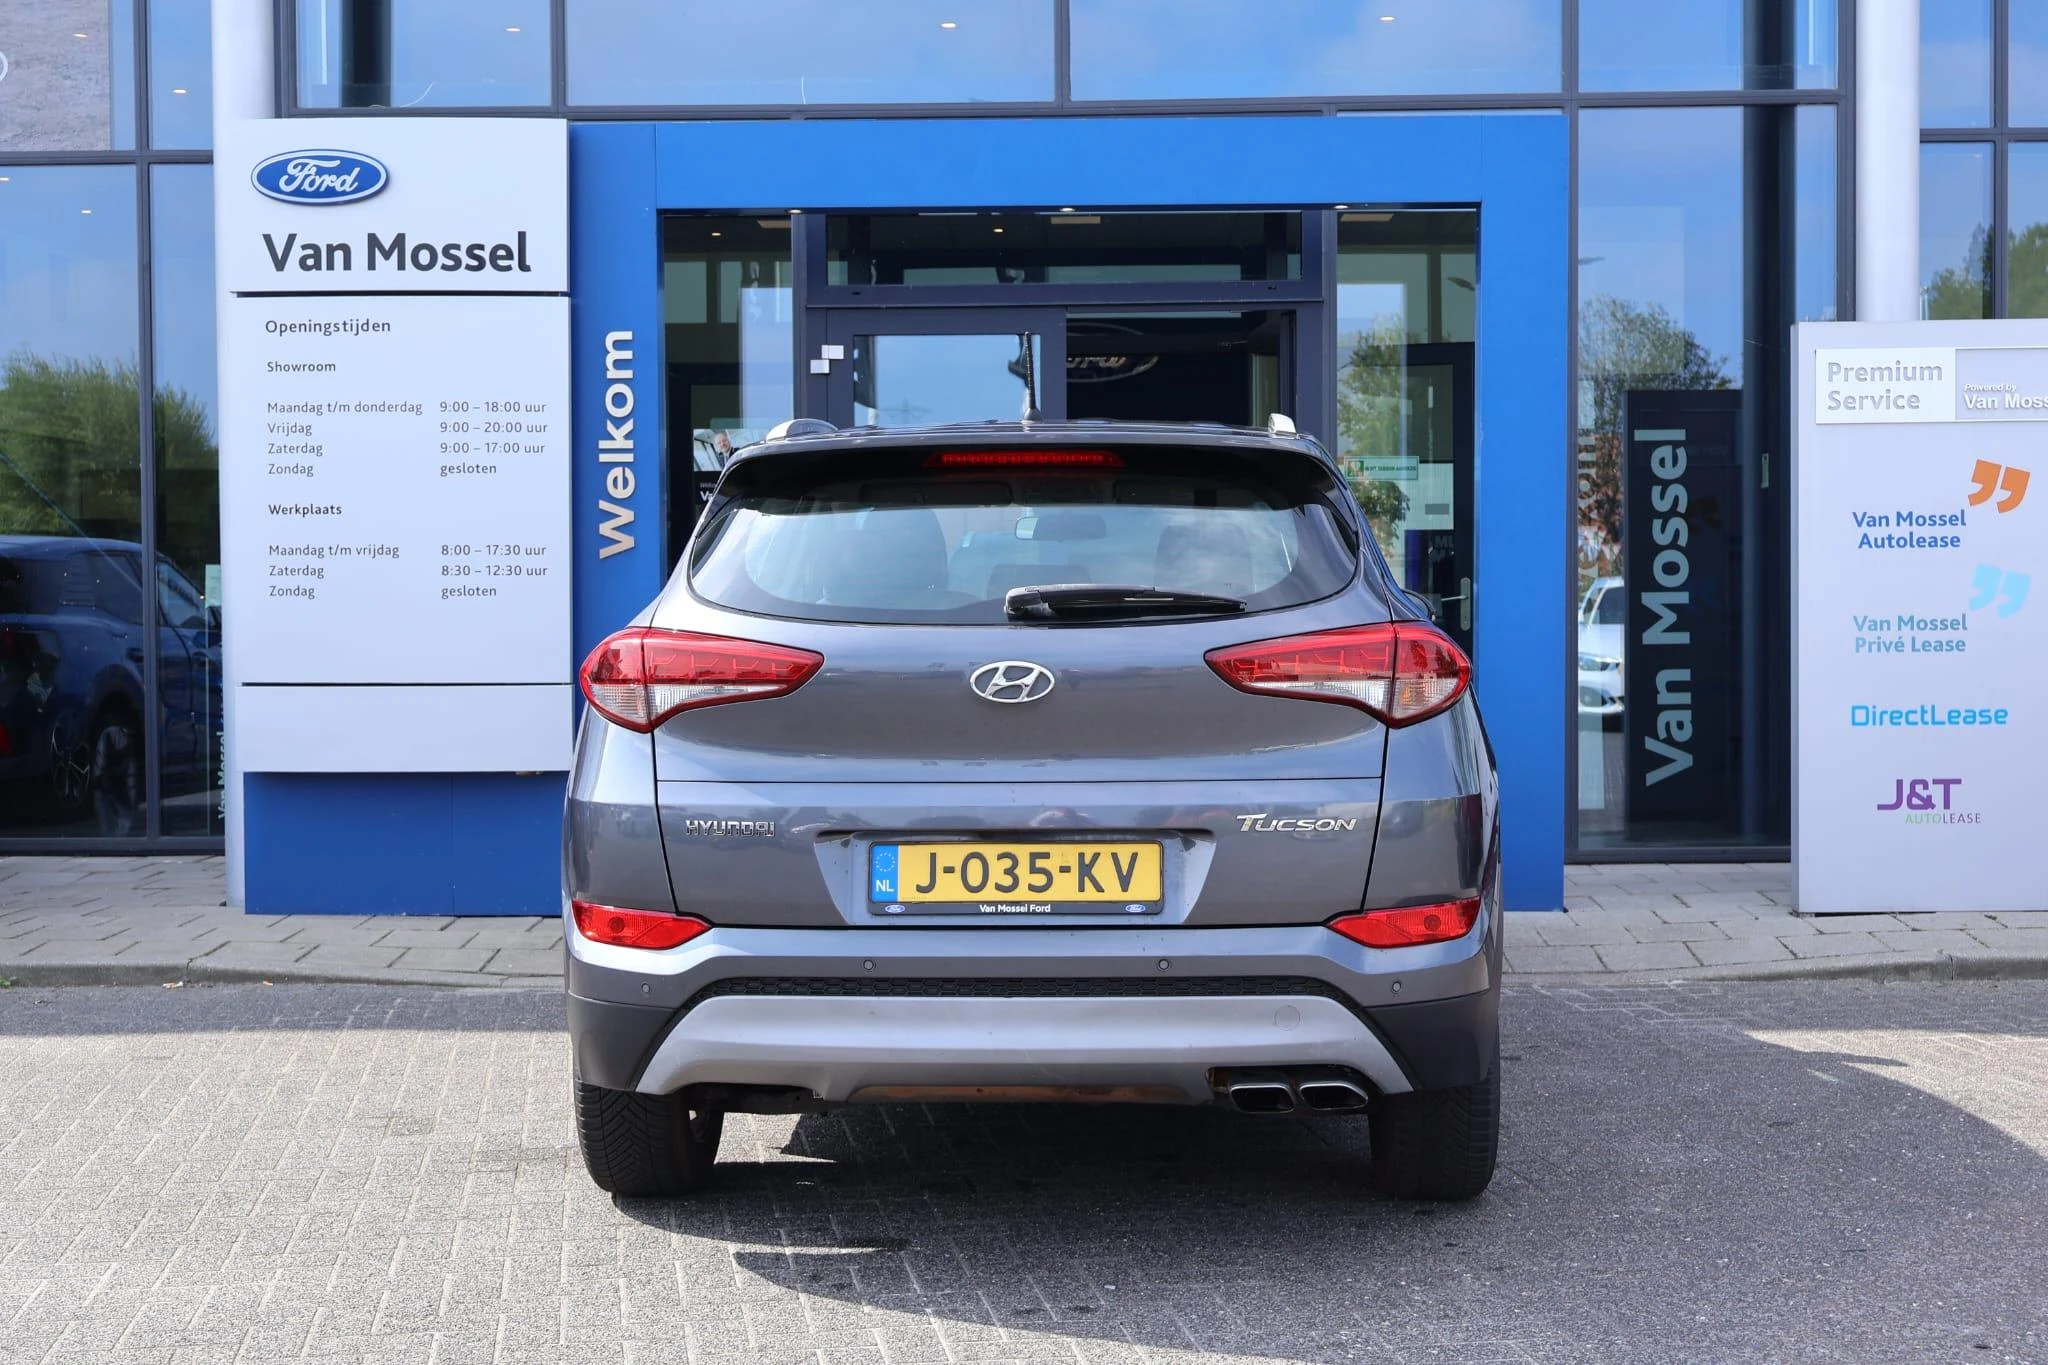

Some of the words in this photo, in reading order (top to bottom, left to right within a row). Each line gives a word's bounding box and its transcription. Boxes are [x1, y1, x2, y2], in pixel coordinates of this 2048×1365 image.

[278, 159, 361, 194] Ford
[262, 233, 352, 272] Van
[367, 231, 532, 272] Mossel
[265, 319, 391, 336] Openingstijden
[267, 361, 336, 373] Showroom
[1827, 360, 1943, 382] Premium
[1964, 383, 2003, 392] Powered
[2005, 383, 2017, 393] by
[1827, 389, 1921, 410] Service
[1964, 392, 1999, 409] Van
[267, 402, 323, 416] Maandag
[325, 402, 350, 413] t/m
[354, 401, 423, 416] donderdag
[440, 402, 470, 413] 9:00
[484, 402, 521, 413] 18:00
[525, 404, 547, 413] uur
[268, 422, 313, 436] Vrijdag
[440, 422, 470, 433] 9:00
[484, 422, 522, 433] 20:00
[526, 424, 548, 433] uur
[268, 442, 323, 457] Zaterdag
[440, 443, 470, 453] 9:00
[484, 443, 520, 453] 17:00
[524, 445, 546, 454] uur
[598, 330, 635, 560] Welkom
[268, 463, 314, 477] Zondag
[440, 463, 497, 477] gesloten
[268, 504, 342, 518] Werkplaats
[1852, 512, 1890, 528] Van
[1896, 509, 1967, 528] Mossel
[1634, 428, 1690, 645] Mossel
[1858, 532, 1961, 549] Autolease
[269, 545, 325, 559] Maandag
[328, 545, 352, 556] t/m
[356, 544, 400, 559] vrijdag
[441, 545, 471, 556] 8:00
[486, 545, 521, 556] 17:30
[525, 547, 547, 556] uur
[269, 565, 325, 579] Zaterdag
[441, 565, 471, 576] 8:30
[487, 565, 522, 576] 12:30
[526, 567, 548, 576] uur
[269, 585, 316, 600] Zondag
[441, 585, 497, 599] gesloten
[1853, 616, 1891, 632] Van
[1897, 613, 1968, 632] Mossel
[1855, 635, 1905, 654] Privé
[1911, 636, 1967, 653] Lease
[1851, 704, 2009, 727] DirectLease
[1645, 668, 1694, 787] Van
[1876, 778, 1962, 811] J&T
[1905, 813, 1982, 824] AUTOLEASE
[686, 820, 775, 836] HYUNDAI
[916, 851, 1139, 893] J-035-KV
[876, 879, 895, 892] NL
[980, 904, 996, 912] Van
[998, 904, 1025, 912] Mossel
[1029, 904, 1051, 912] Ford
